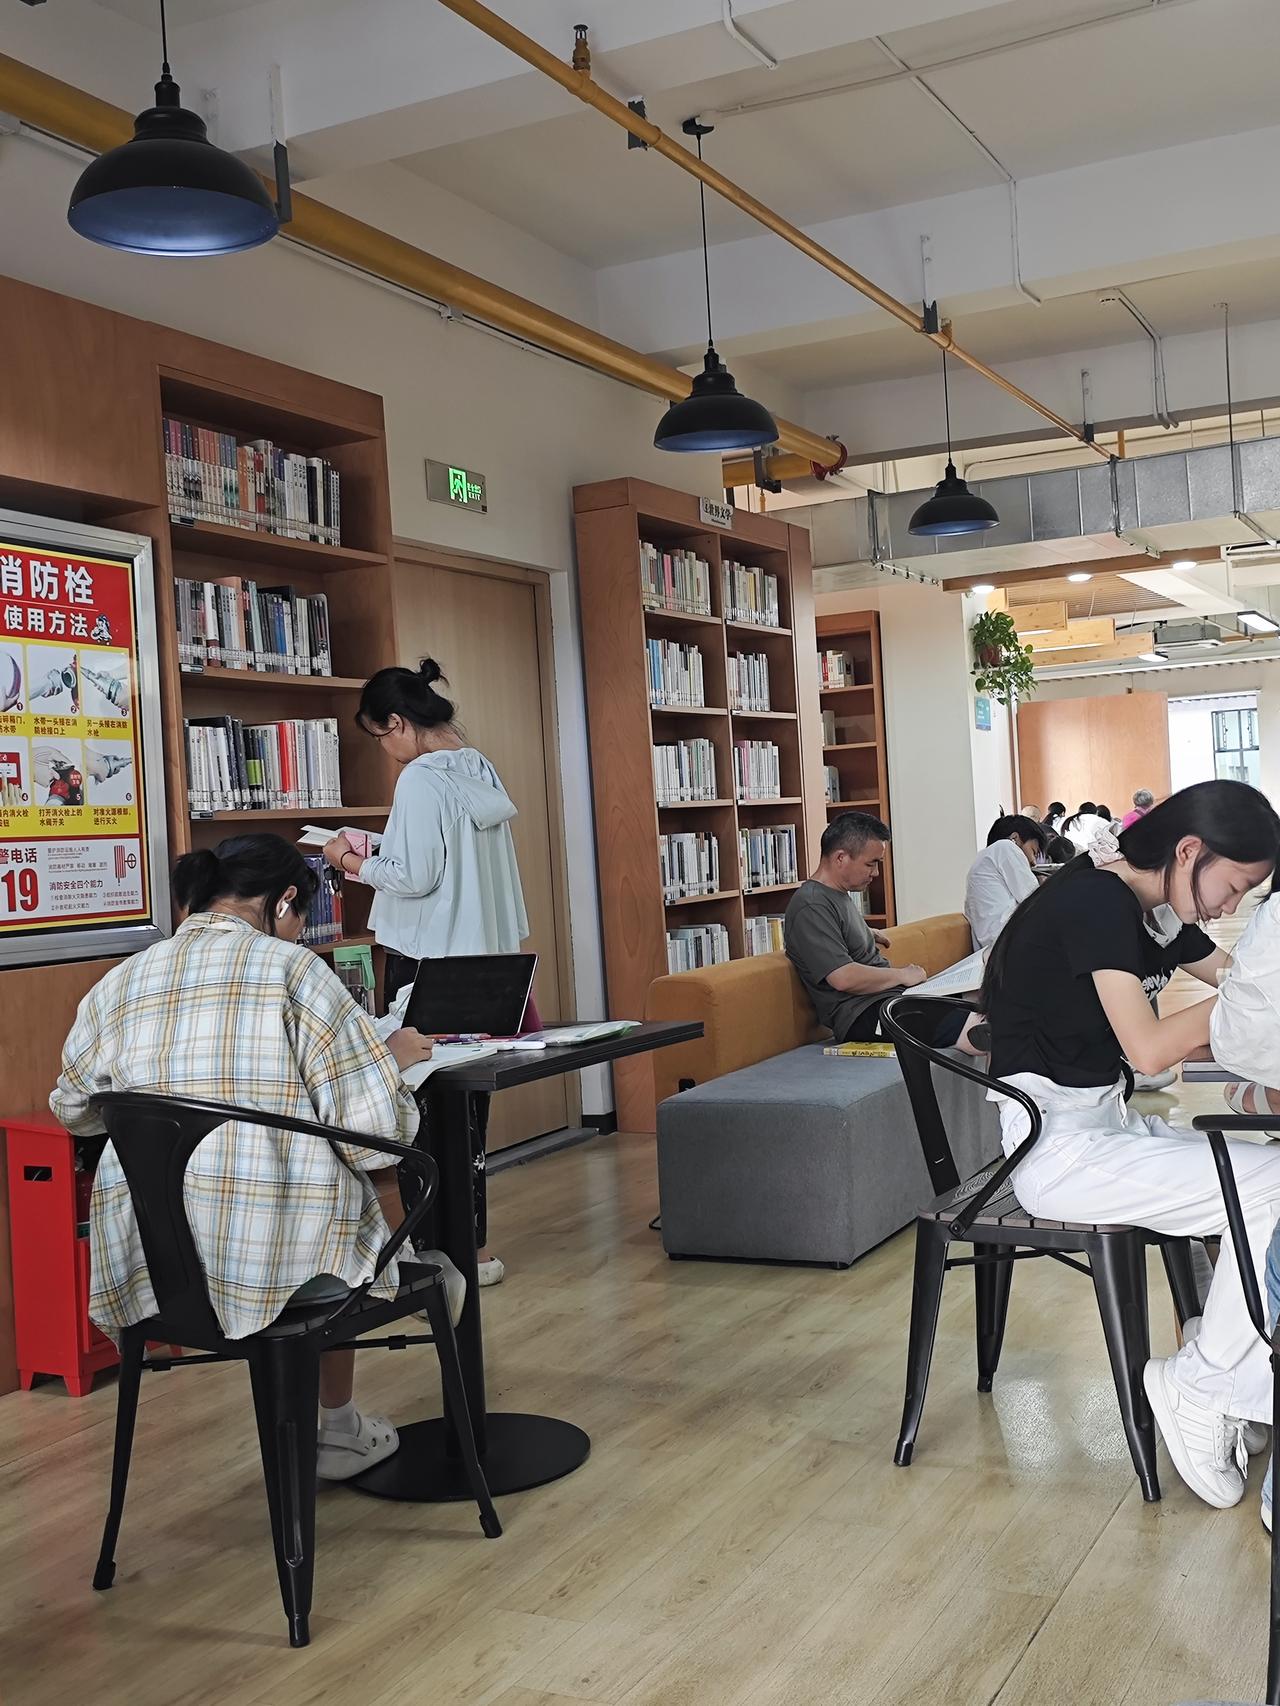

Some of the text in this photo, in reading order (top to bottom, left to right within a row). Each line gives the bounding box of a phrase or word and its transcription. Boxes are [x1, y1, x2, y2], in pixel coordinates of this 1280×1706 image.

[0, 555, 94, 604] 消防栓
[4, 604, 88, 637] 使用方法
[49, 879, 104, 891] 消防安全四个能力
